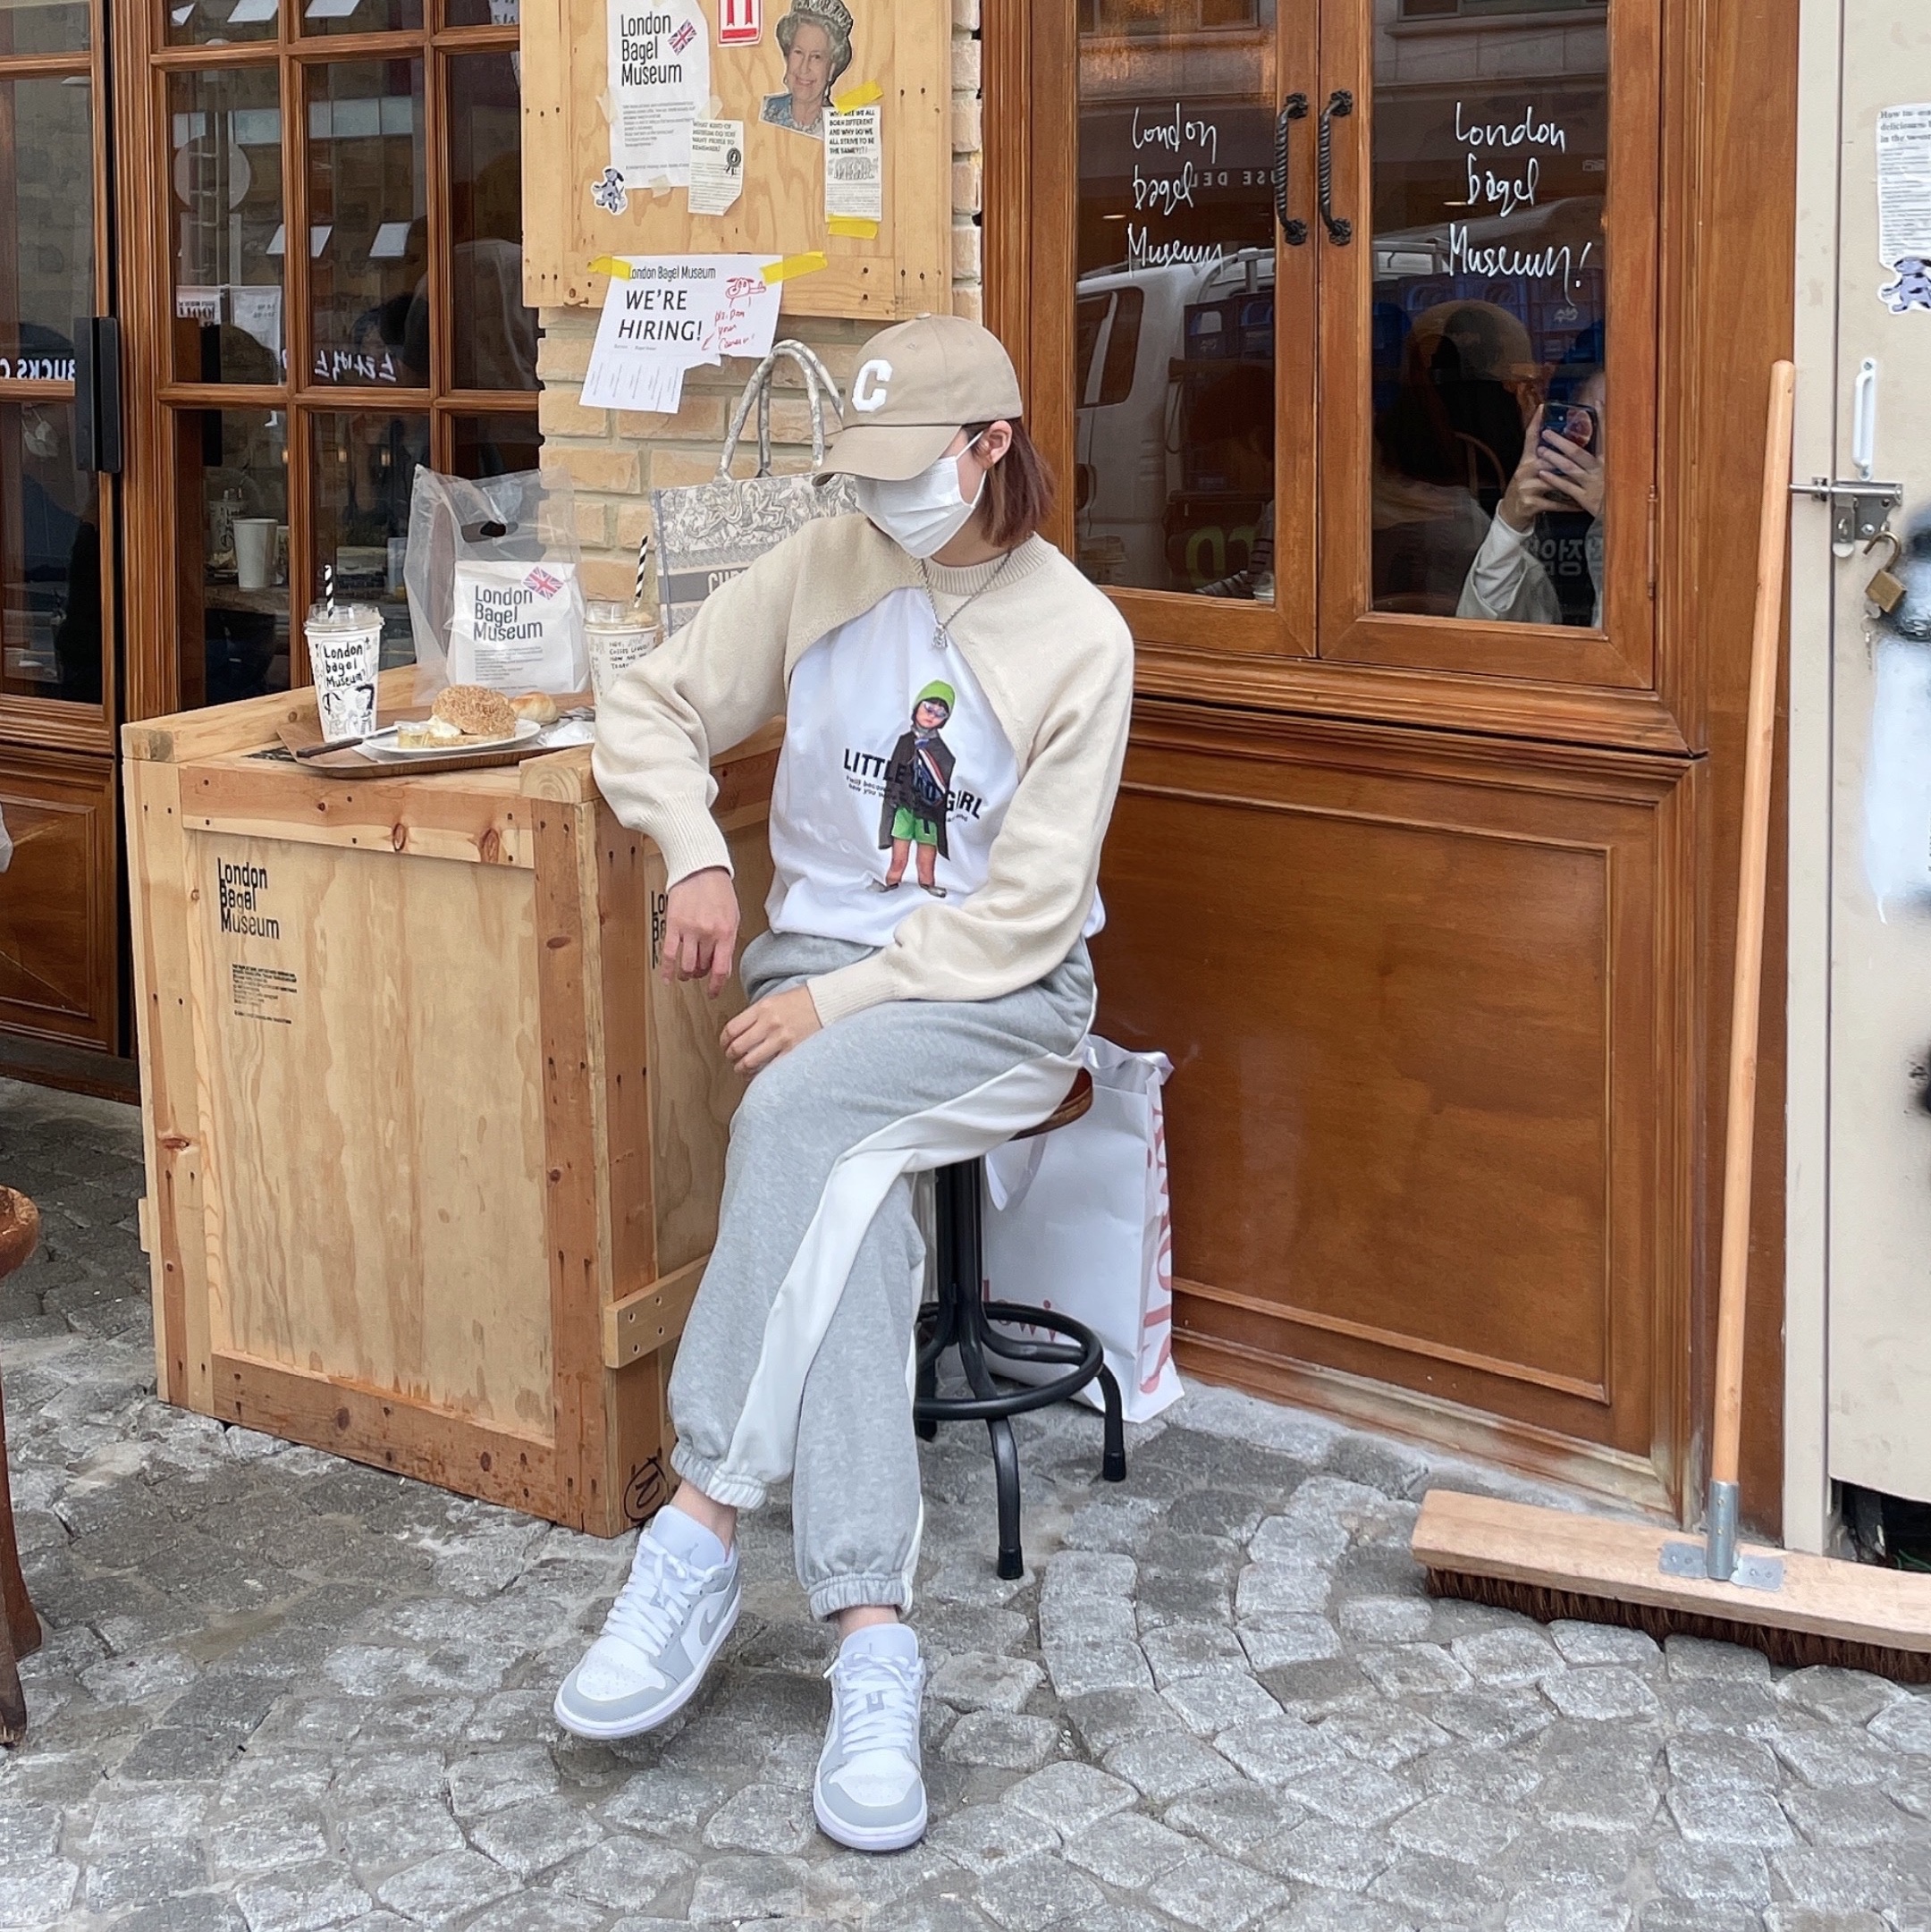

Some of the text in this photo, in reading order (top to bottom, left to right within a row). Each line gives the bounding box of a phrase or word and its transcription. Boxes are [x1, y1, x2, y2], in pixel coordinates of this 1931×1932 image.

[621, 11, 671, 37] London
[621, 36, 658, 65] Bagel
[621, 63, 682, 87] Museum
[1132, 103, 1216, 165] London
[1455, 102, 1565, 154] London
[1133, 162, 1194, 215] bagel
[1467, 153, 1539, 217] bagel
[1127, 223, 1224, 279] Museum
[658, 266, 679, 283] Bagel
[681, 265, 716, 280] Museum
[626, 289, 688, 311] WE'RE
[618, 318, 703, 342] HIRING!
[852, 359, 893, 412] C
[475, 585, 533, 606] London
[475, 602, 518, 628] Bagel
[473, 620, 544, 642] Museum
[324, 641, 363, 660] London
[325, 657, 358, 677] bagel
[843, 747, 907, 785] LITTLE
[945, 789, 982, 820] GIRL
[217, 856, 268, 890] London
[219, 878, 257, 914] Bagel
[221, 907, 281, 941] Museum
